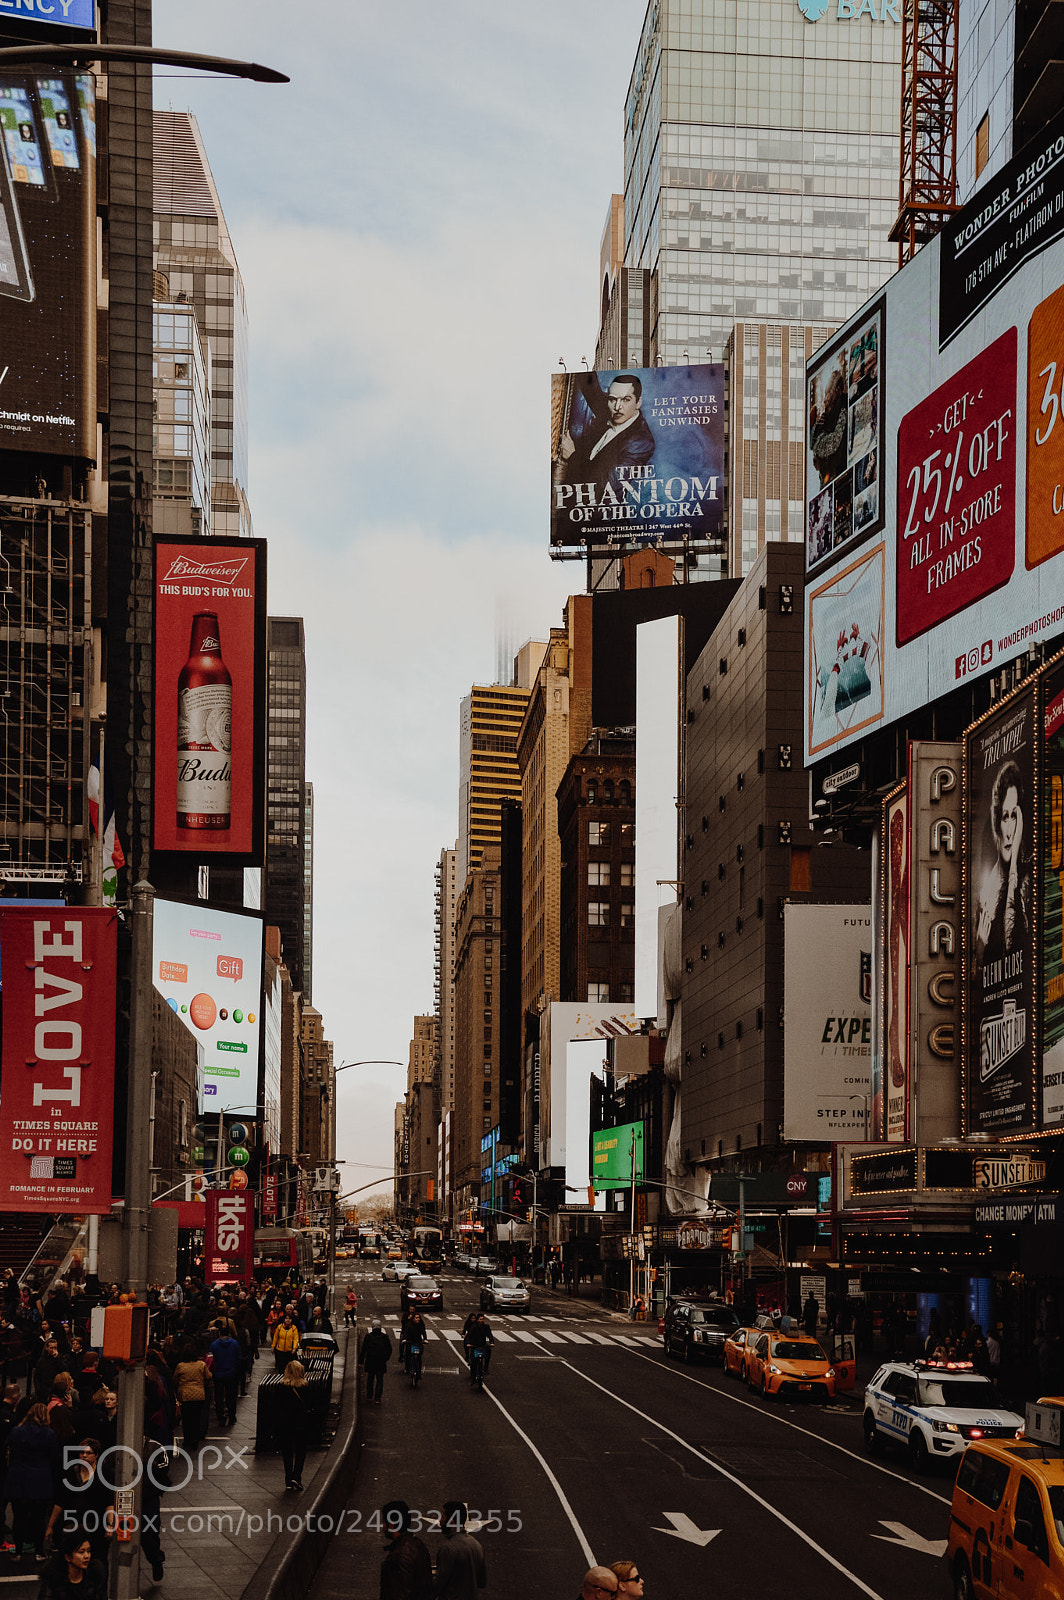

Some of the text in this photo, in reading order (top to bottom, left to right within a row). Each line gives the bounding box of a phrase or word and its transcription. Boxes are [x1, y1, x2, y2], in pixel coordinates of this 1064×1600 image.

[954, 135, 1064, 250] WONDER PHOTO
[1009, 182, 1044, 223] FUJIFILM
[965, 274, 977, 294] 176
[979, 260, 992, 283] 5TH
[994, 243, 1008, 269] AVE
[1015, 203, 1052, 249] FLATIRON
[654, 395, 717, 406] LET YOUR
[652, 405, 718, 416] FANTASIES
[46, 415, 75, 426] Netflix
[659, 416, 710, 426] UNWIND
[616, 465, 656, 480] THE
[903, 408, 1011, 540] 25% OFF
[554, 476, 719, 509] PHANTOM
[569, 502, 704, 522] OF THE OPERA
[910, 483, 1002, 570] ALL IN-STORE
[170, 561, 239, 575] Budweiser
[927, 536, 982, 594] FRAMES
[159, 585, 253, 598] THIS BUD'S FOR YOU.
[984, 721, 1025, 770] TRIUMPH!
[929, 766, 957, 1057] PALACE
[162, 963, 185, 974] Birthday
[219, 960, 240, 975] Gift
[982, 949, 1024, 989] GLENN CLOSE
[33, 921, 83, 1106] LOVE
[219, 1042, 230, 1050] Your
[985, 1019, 1014, 1071] SUNSET
[51, 1107, 62, 1117] in
[817, 1109, 847, 1118] STEP
[13, 1121, 98, 1131] TIMES SQUARE
[12, 1138, 97, 1152] DO IT HERE
[981, 1163, 1026, 1188] SUNSET
[10, 1185, 46, 1193] ROMANCE
[57, 1186, 95, 1194] FEBRUARY
[266, 1176, 275, 1201] LOVE
[786, 1181, 807, 1191] CNY
[975, 1204, 1056, 1222] CHANGE MONEY ATM
[217, 1195, 246, 1252] tkts
[892, 1410, 908, 1430] NYPD
